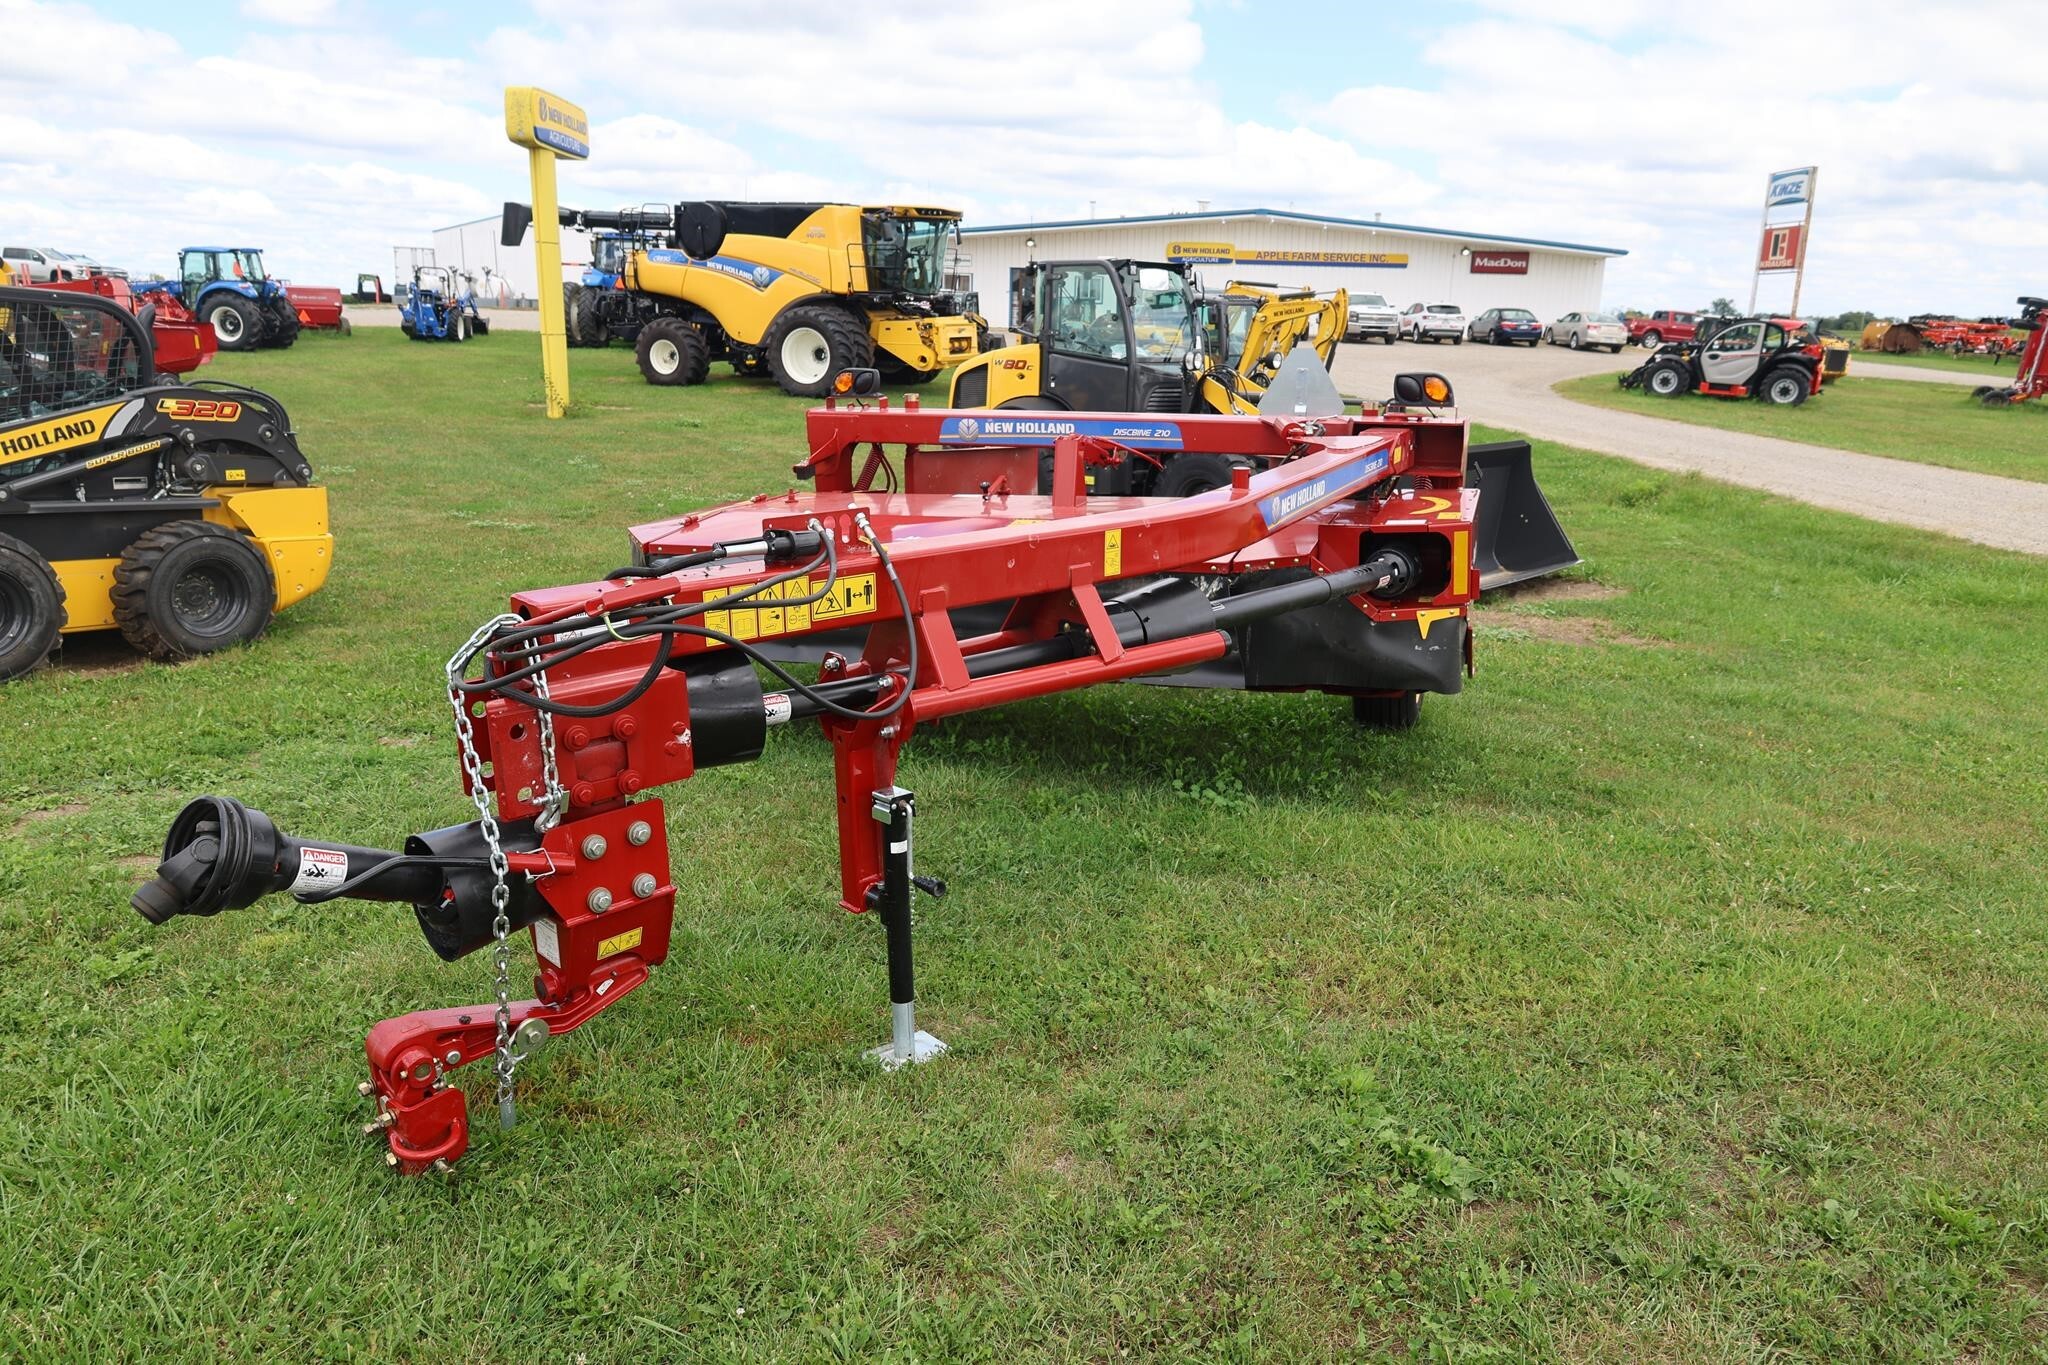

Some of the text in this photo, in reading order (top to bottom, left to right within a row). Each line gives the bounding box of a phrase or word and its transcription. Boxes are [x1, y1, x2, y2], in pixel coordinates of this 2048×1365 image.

[548, 107, 587, 135] NEW HOLLAND
[1770, 181, 1804, 197] KINZE
[1256, 251, 1390, 264] APPLE FARM SERVICE INC.
[1475, 257, 1527, 268] MacDon
[706, 261, 753, 280] NEW HOLLAND
[1285, 307, 1305, 315] HOLLAND
[157, 399, 241, 420] L320
[985, 421, 1075, 435] NEW HOLLAND
[1113, 428, 1171, 437] DISCBINE 210
[0, 419, 97, 456] HOLLAND
[86, 439, 161, 469] SUPER BOOM
[1281, 480, 1326, 516] NEW HOLLAND
[313, 853, 345, 864] DANGER
